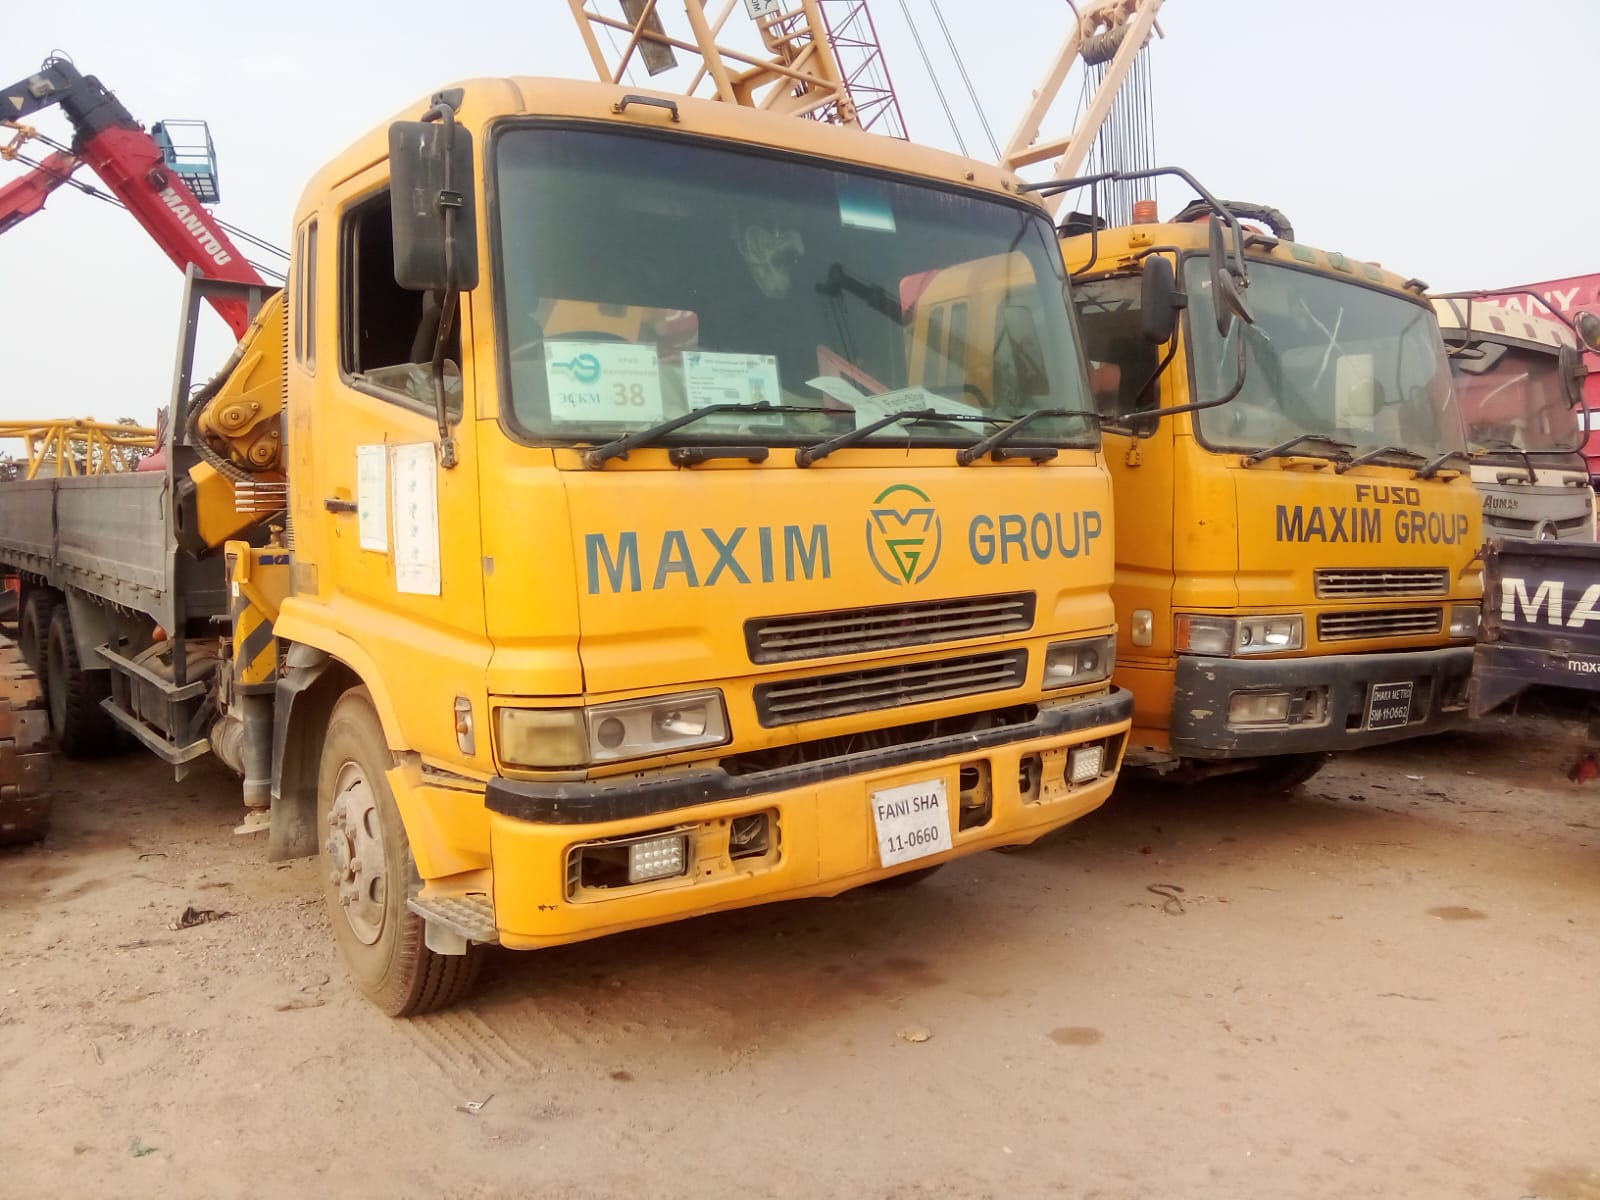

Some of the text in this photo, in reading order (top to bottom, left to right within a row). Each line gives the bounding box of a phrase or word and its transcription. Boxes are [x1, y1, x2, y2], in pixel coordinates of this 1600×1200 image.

[159, 187, 232, 266] MANITOU
[613, 383, 646, 407] 38
[1356, 484, 1421, 507] FUSO
[1275, 504, 1469, 545] MAXIM GROUP
[585, 510, 1102, 594] MAXIM GROUP
[1373, 688, 1411, 702] DHAKA METRO
[878, 793, 939, 821] FANI SHA
[887, 825, 939, 853] 11-0660
